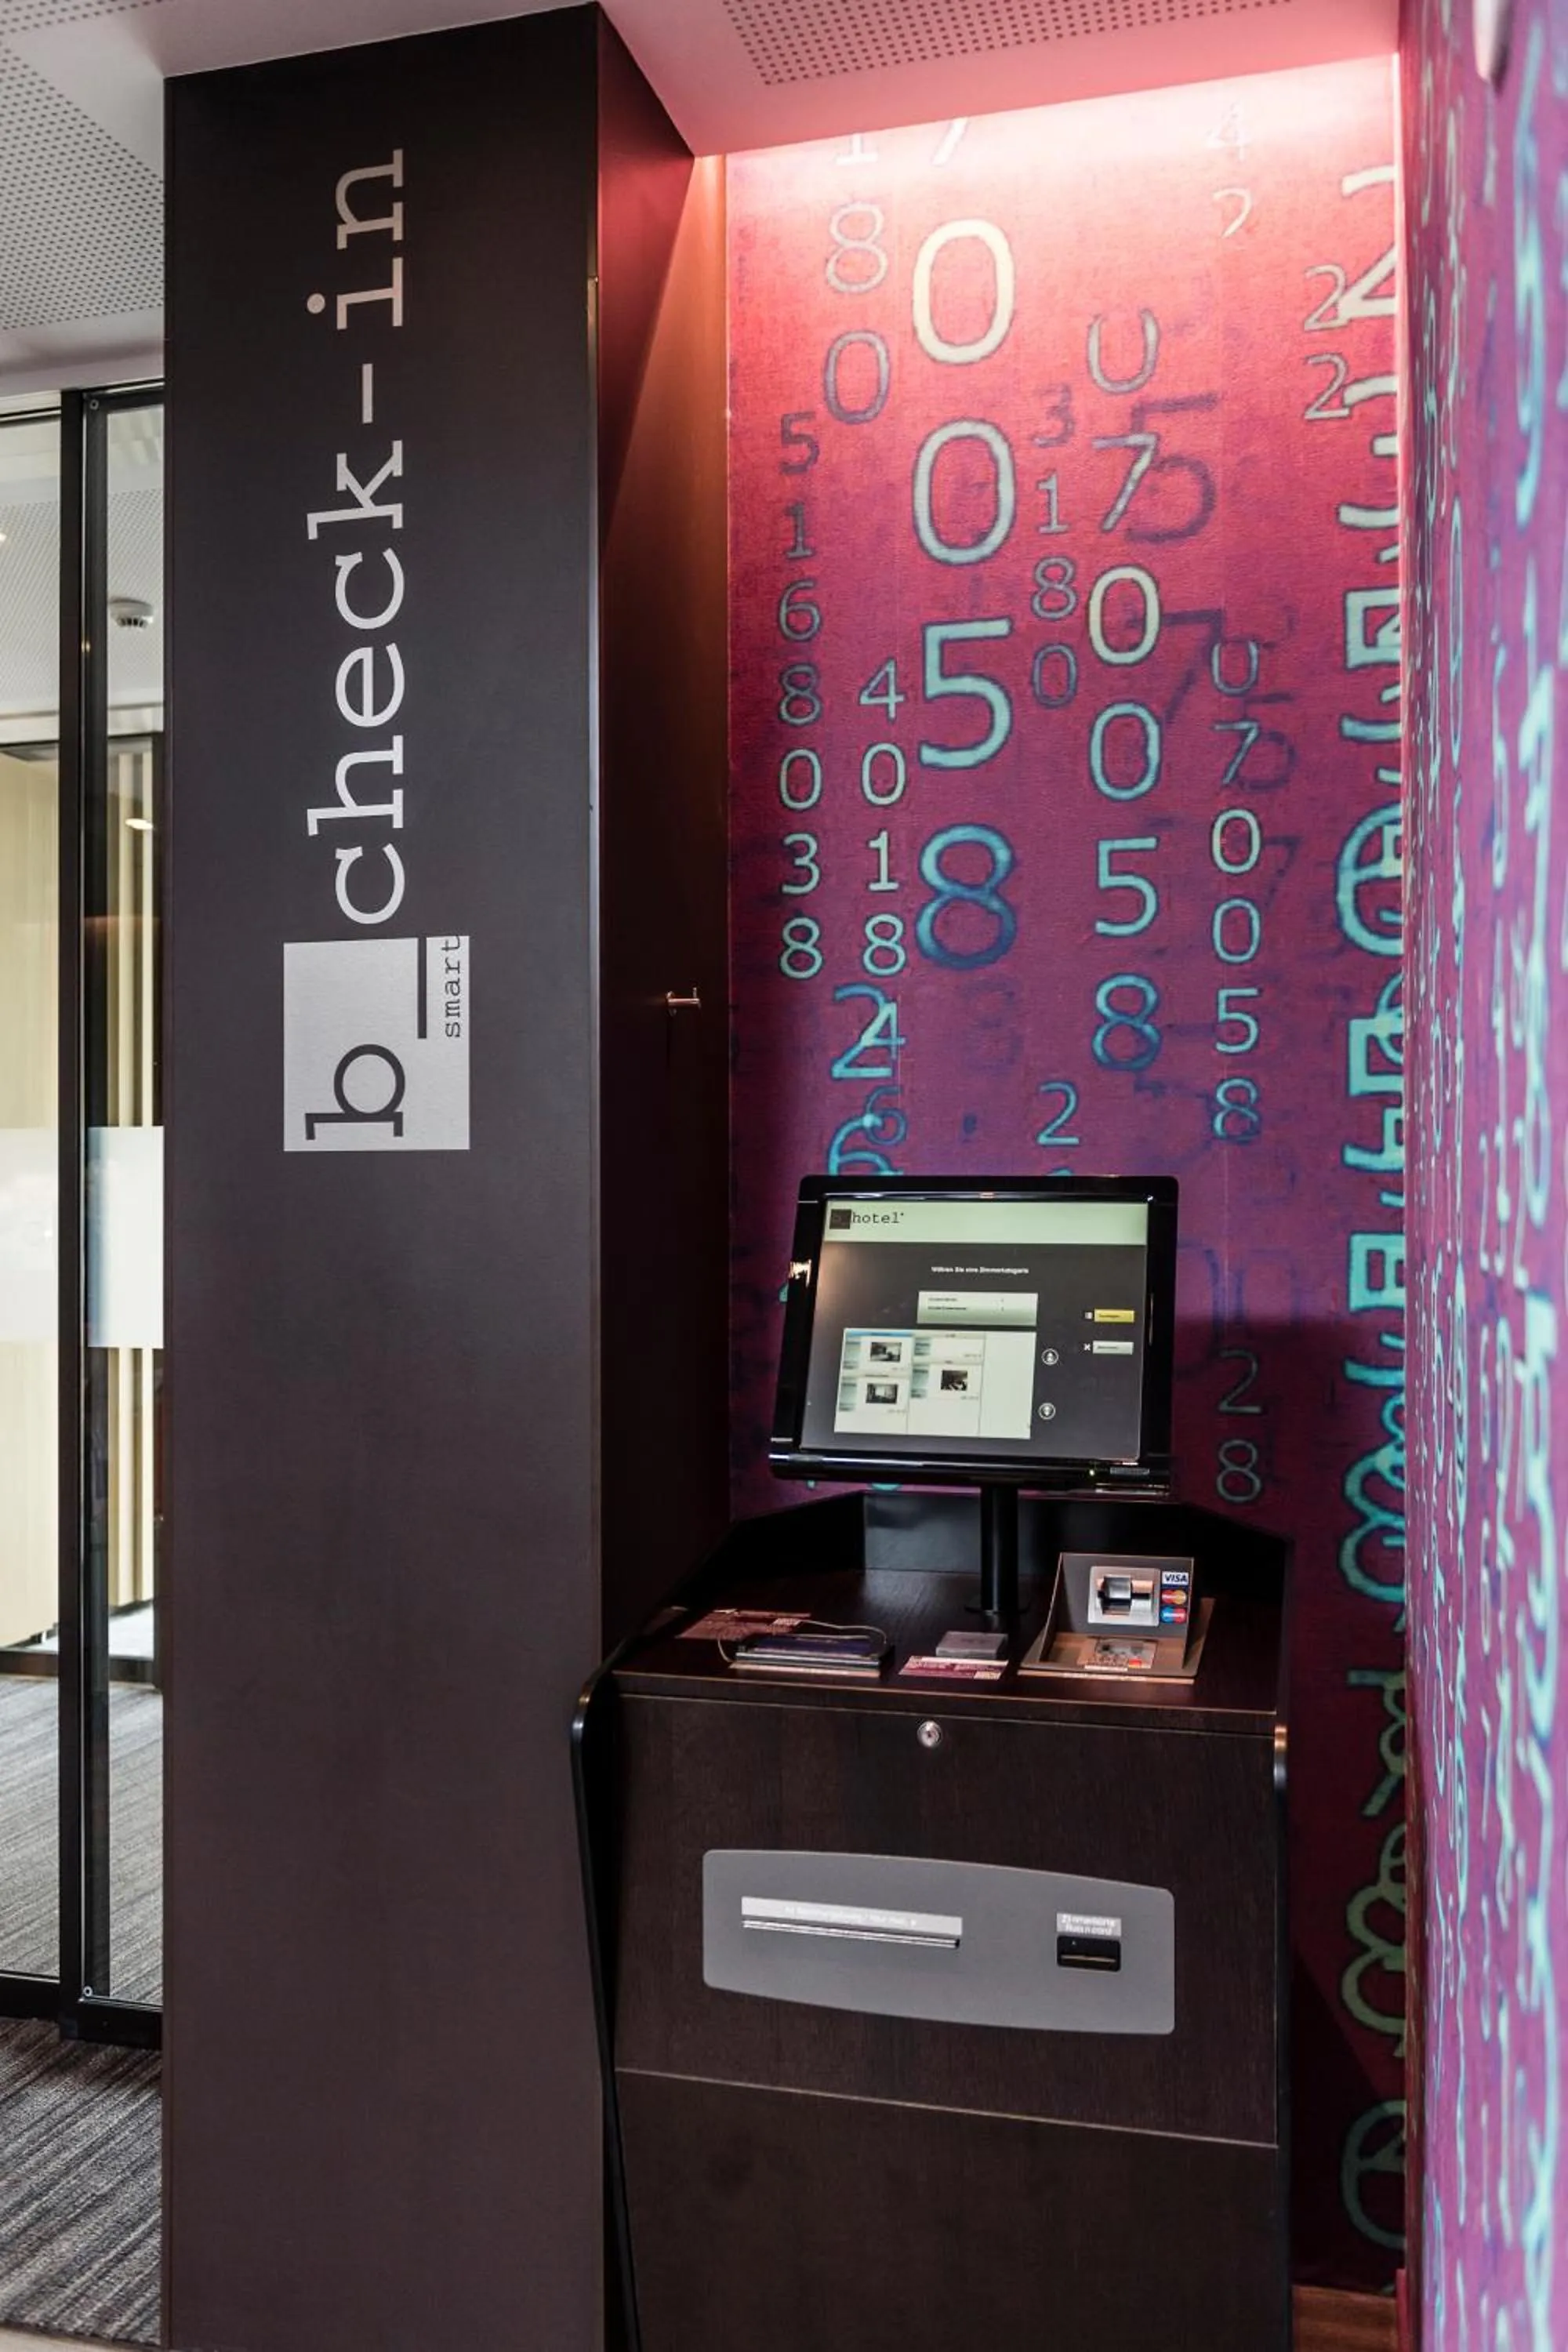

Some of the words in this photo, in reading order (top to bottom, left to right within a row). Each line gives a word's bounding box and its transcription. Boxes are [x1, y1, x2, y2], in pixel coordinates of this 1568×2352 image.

[827, 201, 888, 295] 8
[913, 218, 1015, 365] 0
[824, 330, 890, 425] 0
[913, 417, 1015, 564] 0
[1037, 469, 1070, 535] 1
[307, 148, 405, 925] check-in
[779, 579, 821, 642] 6
[1031, 557, 1079, 621] 8
[1087, 565, 1161, 666] 0
[779, 662, 822, 726] 8
[859, 656, 906, 722] 4
[920, 615, 1013, 771] 5
[1031, 644, 1079, 710] 0
[779, 748, 823, 811] 0
[860, 741, 907, 807] 0
[1088, 702, 1162, 802] 0
[781, 832, 822, 895] 3
[868, 829, 901, 892] 1
[1210, 808, 1261, 876] 0
[915, 823, 1016, 971] 8
[1094, 836, 1159, 938] 5
[779, 916, 824, 979] 8
[862, 913, 908, 977] 8
[1211, 898, 1261, 964] 0
[441, 934, 463, 1039] smart
[1214, 986, 1261, 1054] 5
[831, 982, 893, 1079] 2
[1091, 973, 1161, 1073] 8
[1036, 1080, 1080, 1147] 2
[1164, 1573, 1188, 1583] VISA
